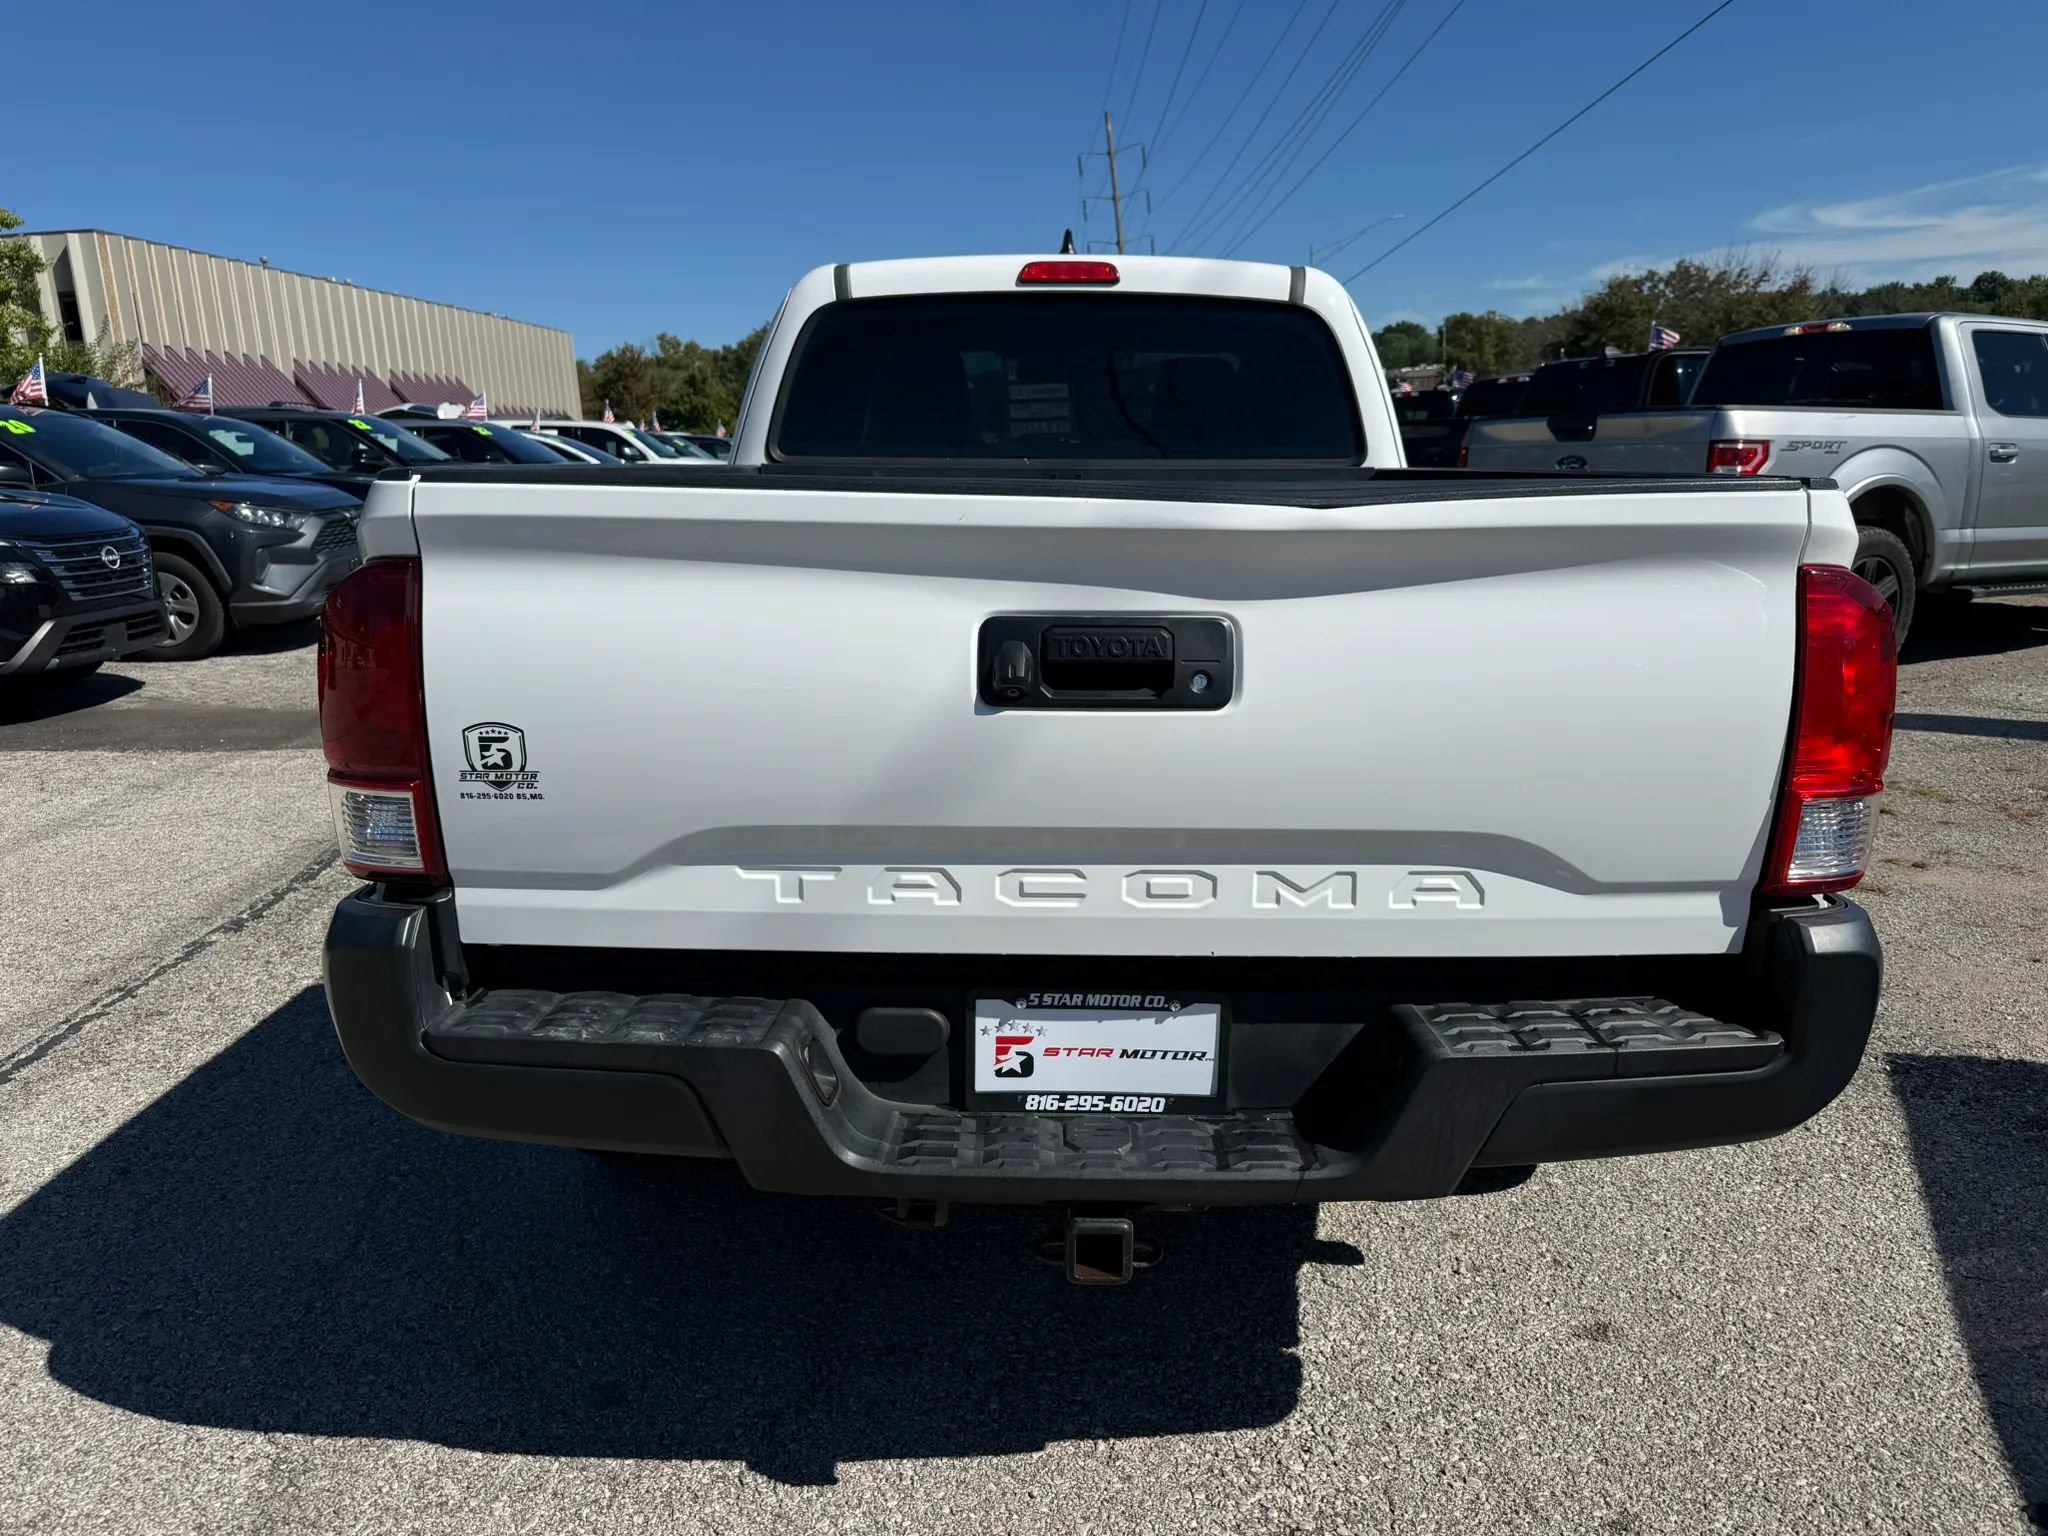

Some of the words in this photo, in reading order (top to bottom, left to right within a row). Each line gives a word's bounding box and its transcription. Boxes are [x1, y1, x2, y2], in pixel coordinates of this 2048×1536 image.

[1779, 440, 1848, 451] SPORT
[1054, 635, 1165, 657] TOYOTA
[460, 792, 514, 800] 816-295-6020
[735, 865, 1485, 909] TACOMA
[1027, 993, 1040, 1005] 5
[1042, 994, 1083, 1006] STAR
[1085, 994, 1142, 1008] MOTOR
[1144, 995, 1169, 1008] CO.
[1043, 1047, 1115, 1057] STAR
[1119, 1048, 1206, 1061] MOTOR
[1025, 1095, 1166, 1113] 816-295-6020
